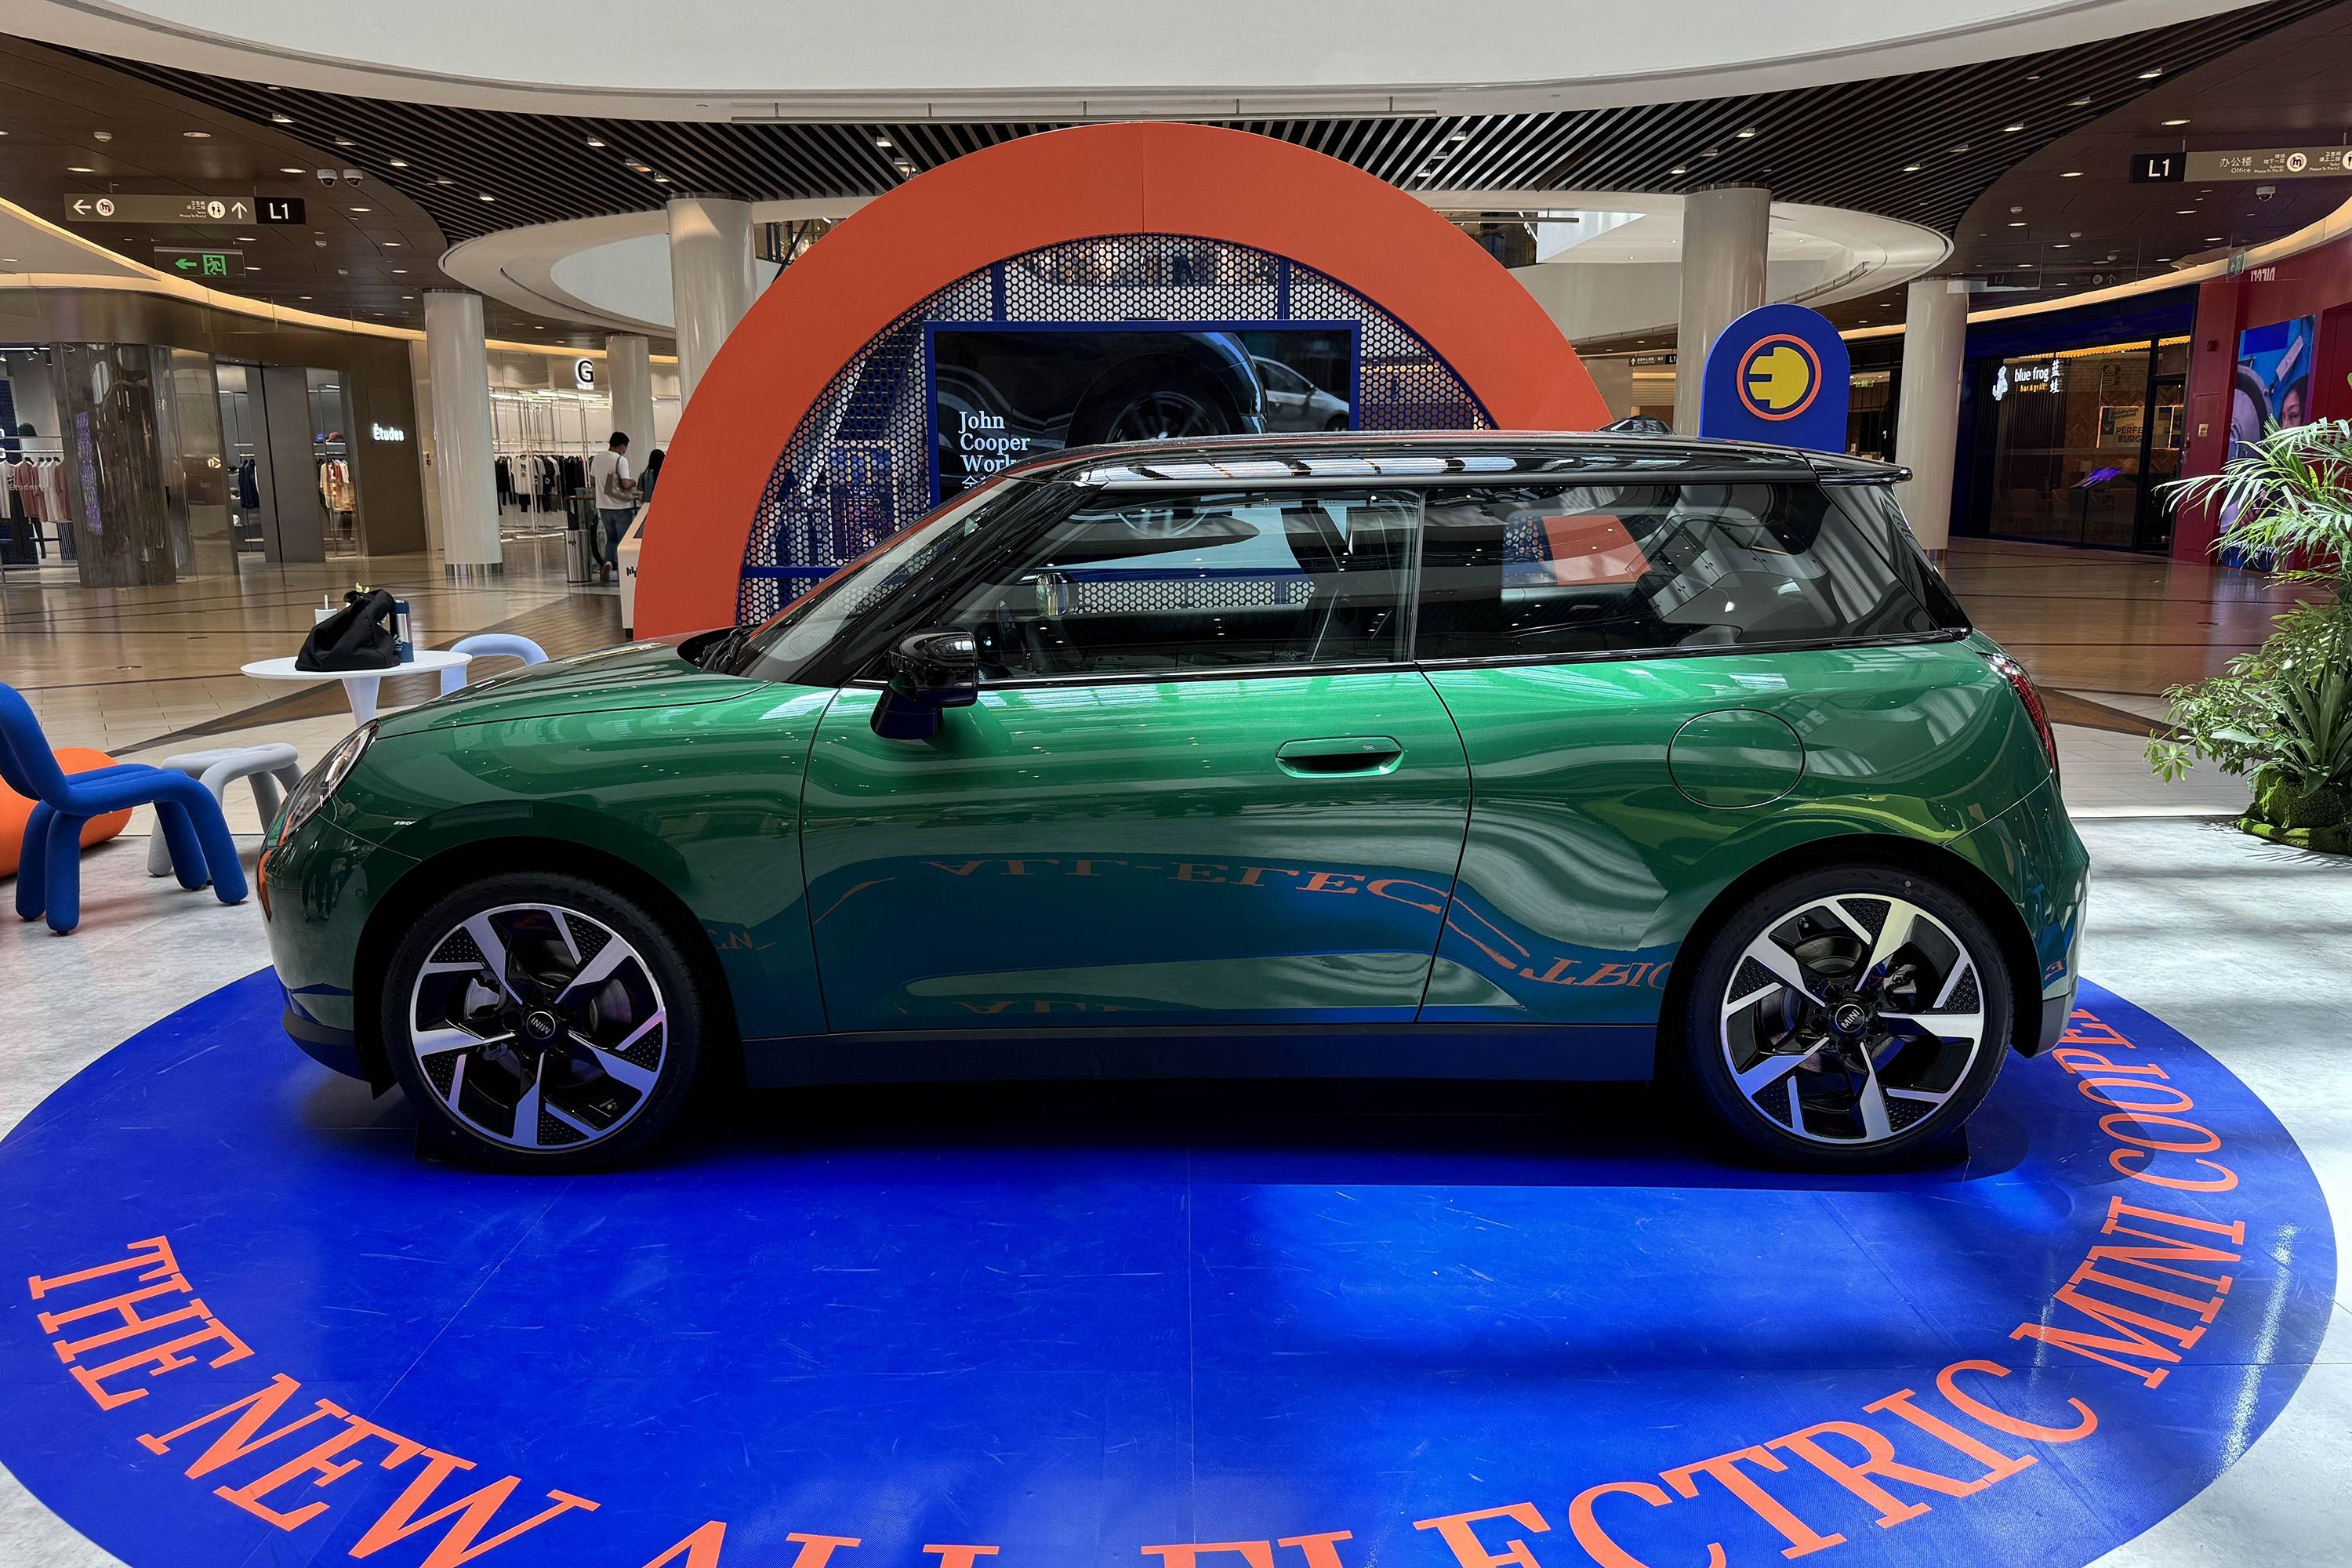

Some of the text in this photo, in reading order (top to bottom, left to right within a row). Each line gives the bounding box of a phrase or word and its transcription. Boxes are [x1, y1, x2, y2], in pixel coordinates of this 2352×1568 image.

[2148, 158, 2170, 177] L1
[2220, 156, 2252, 168] 办公楼
[269, 202, 289, 220] L1
[2014, 366, 2049, 383] blue frog
[958, 410, 1005, 434] John
[960, 433, 1031, 456] Cooper
[960, 454, 1018, 472] Work
[530, 1017, 551, 1035] MINI
[1840, 1008, 1860, 1029] MINI
[2052, 1009, 2238, 1192] COOPE
[2009, 1196, 2245, 1389] MINI
[28, 1236, 255, 1410] THE
[136, 1374, 601, 1568] NEW
